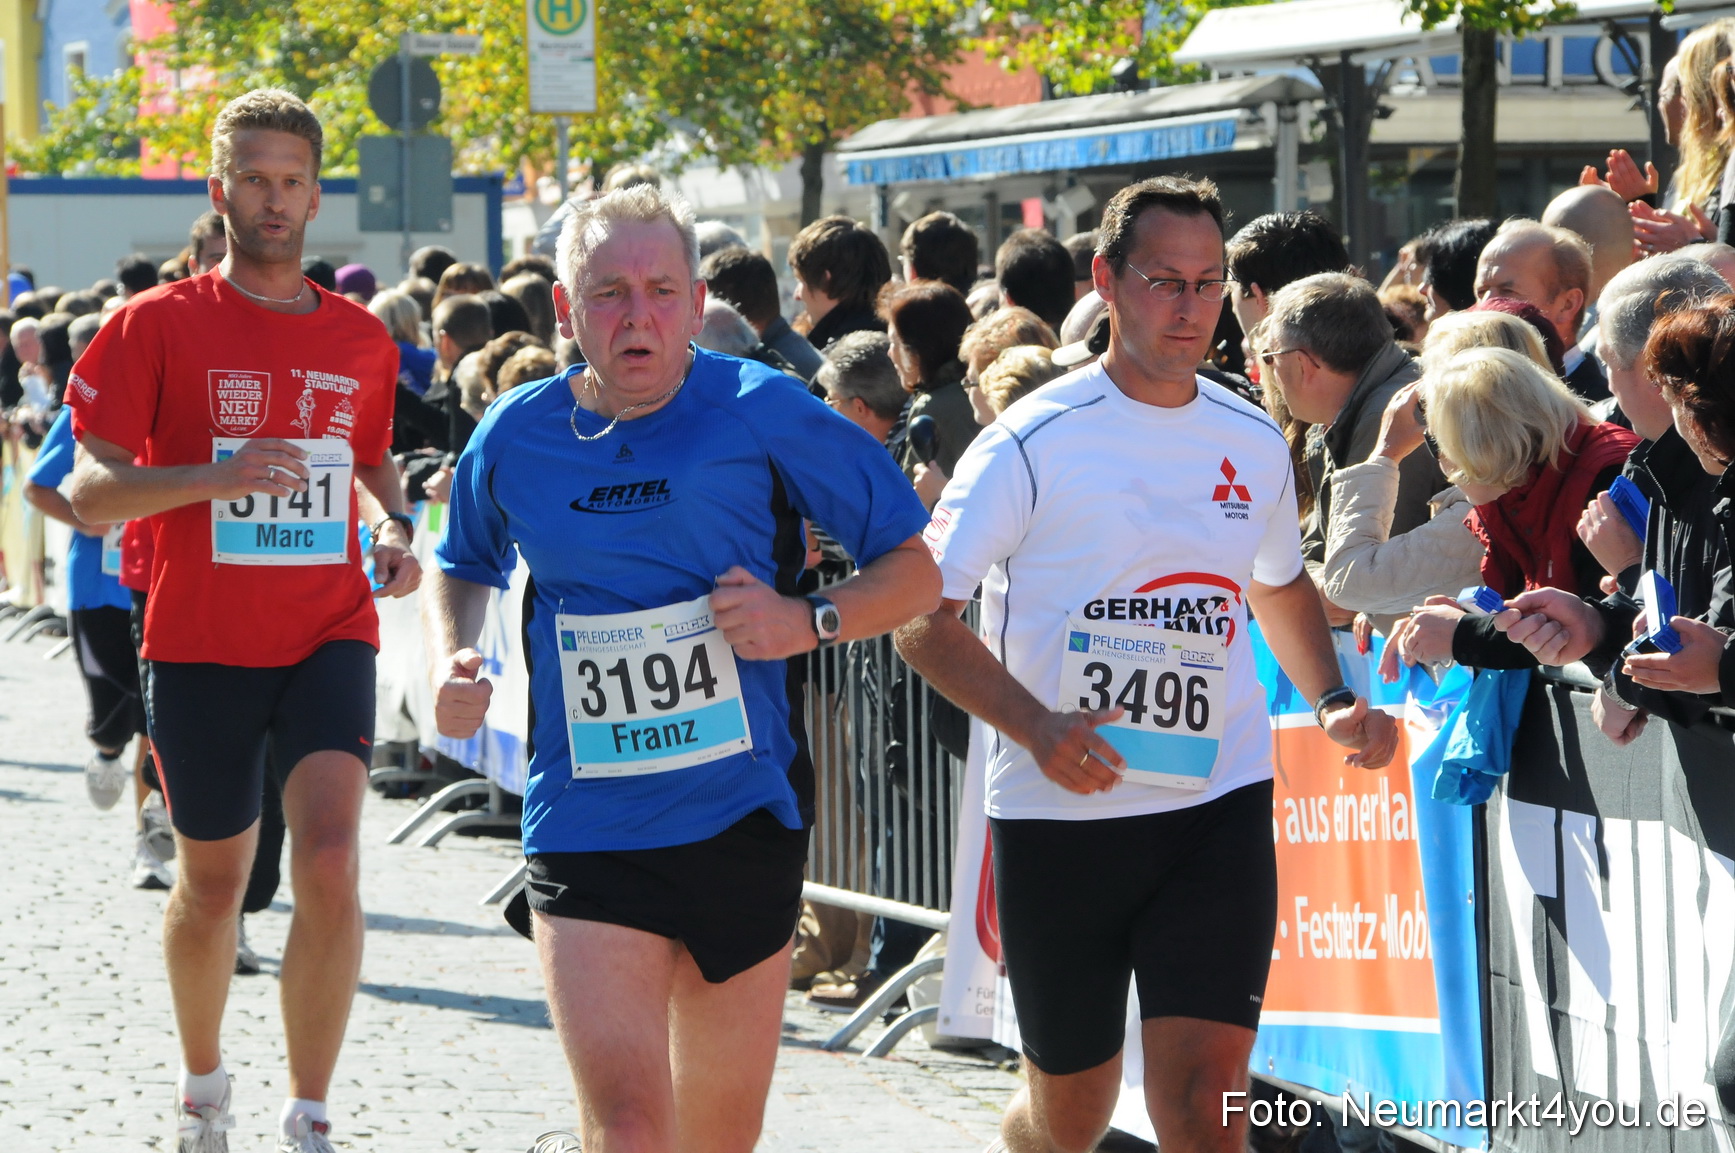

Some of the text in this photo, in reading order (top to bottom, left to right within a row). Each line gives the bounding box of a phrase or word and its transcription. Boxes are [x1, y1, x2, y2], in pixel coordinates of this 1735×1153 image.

[218, 379, 261, 390] IMMER
[291, 369, 359, 390] 11. NEUMARKTER
[305, 379, 353, 395] STADTLAUF
[217, 390, 262, 400] WIEDER
[219, 400, 260, 415] NEU
[219, 416, 259, 425] MARKT
[588, 479, 671, 502] ERTEL
[587, 494, 671, 509] AUTOMOBILE
[1220, 502, 1250, 511] MITSUBISHI
[1225, 512, 1249, 520] MOTORS
[256, 524, 314, 547] Marc
[576, 615, 710, 645] PFLEIDERER BOCK
[1091, 648, 1166, 665] AKTIENGESELLSCHAFT
[1092, 634, 1215, 664] PFLEIDERER BOCK
[577, 642, 718, 717] 3194
[1079, 661, 1210, 732] 3496
[611, 719, 699, 754] Franz
[1284, 795, 1330, 844] aus
